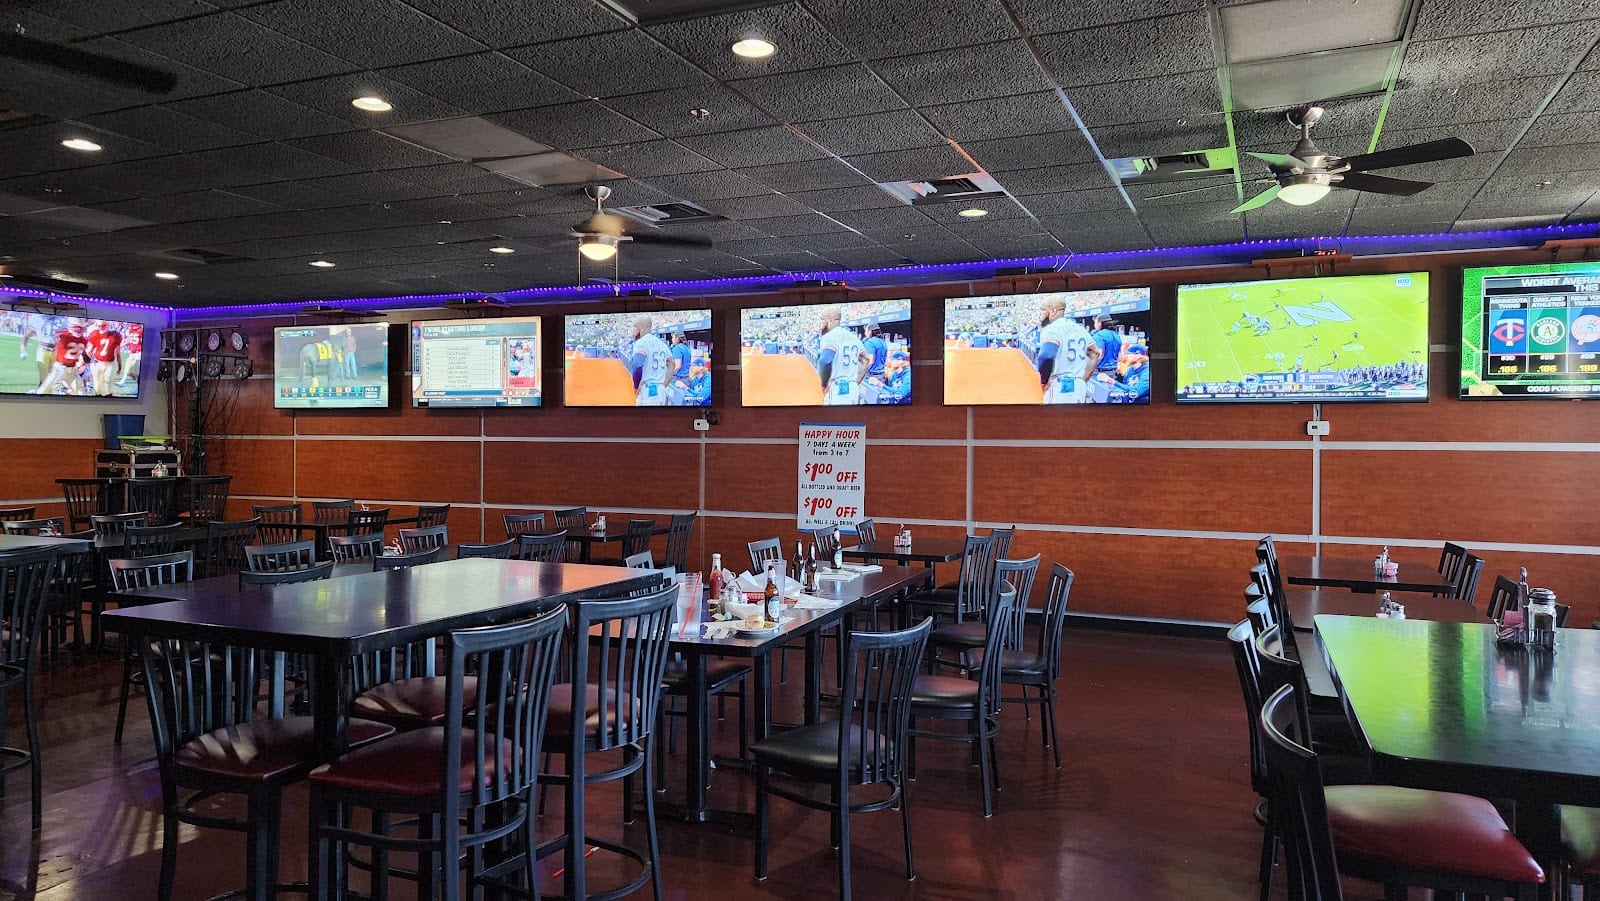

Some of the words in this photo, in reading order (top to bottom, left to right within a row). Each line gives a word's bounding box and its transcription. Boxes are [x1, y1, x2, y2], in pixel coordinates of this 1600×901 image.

[1520, 278, 1560, 287] WORST
[1575, 284, 1599, 292] THIS
[99, 338, 110, 357] 7
[1066, 337, 1087, 362] 53
[650, 351, 666, 370] 53
[842, 345, 859, 367] 53
[1527, 385, 1550, 393] ODDS
[804, 430, 832, 439] HAPPY
[835, 430, 860, 439] HOUR
[836, 471, 858, 483] OFF
[835, 506, 858, 518] OFF
